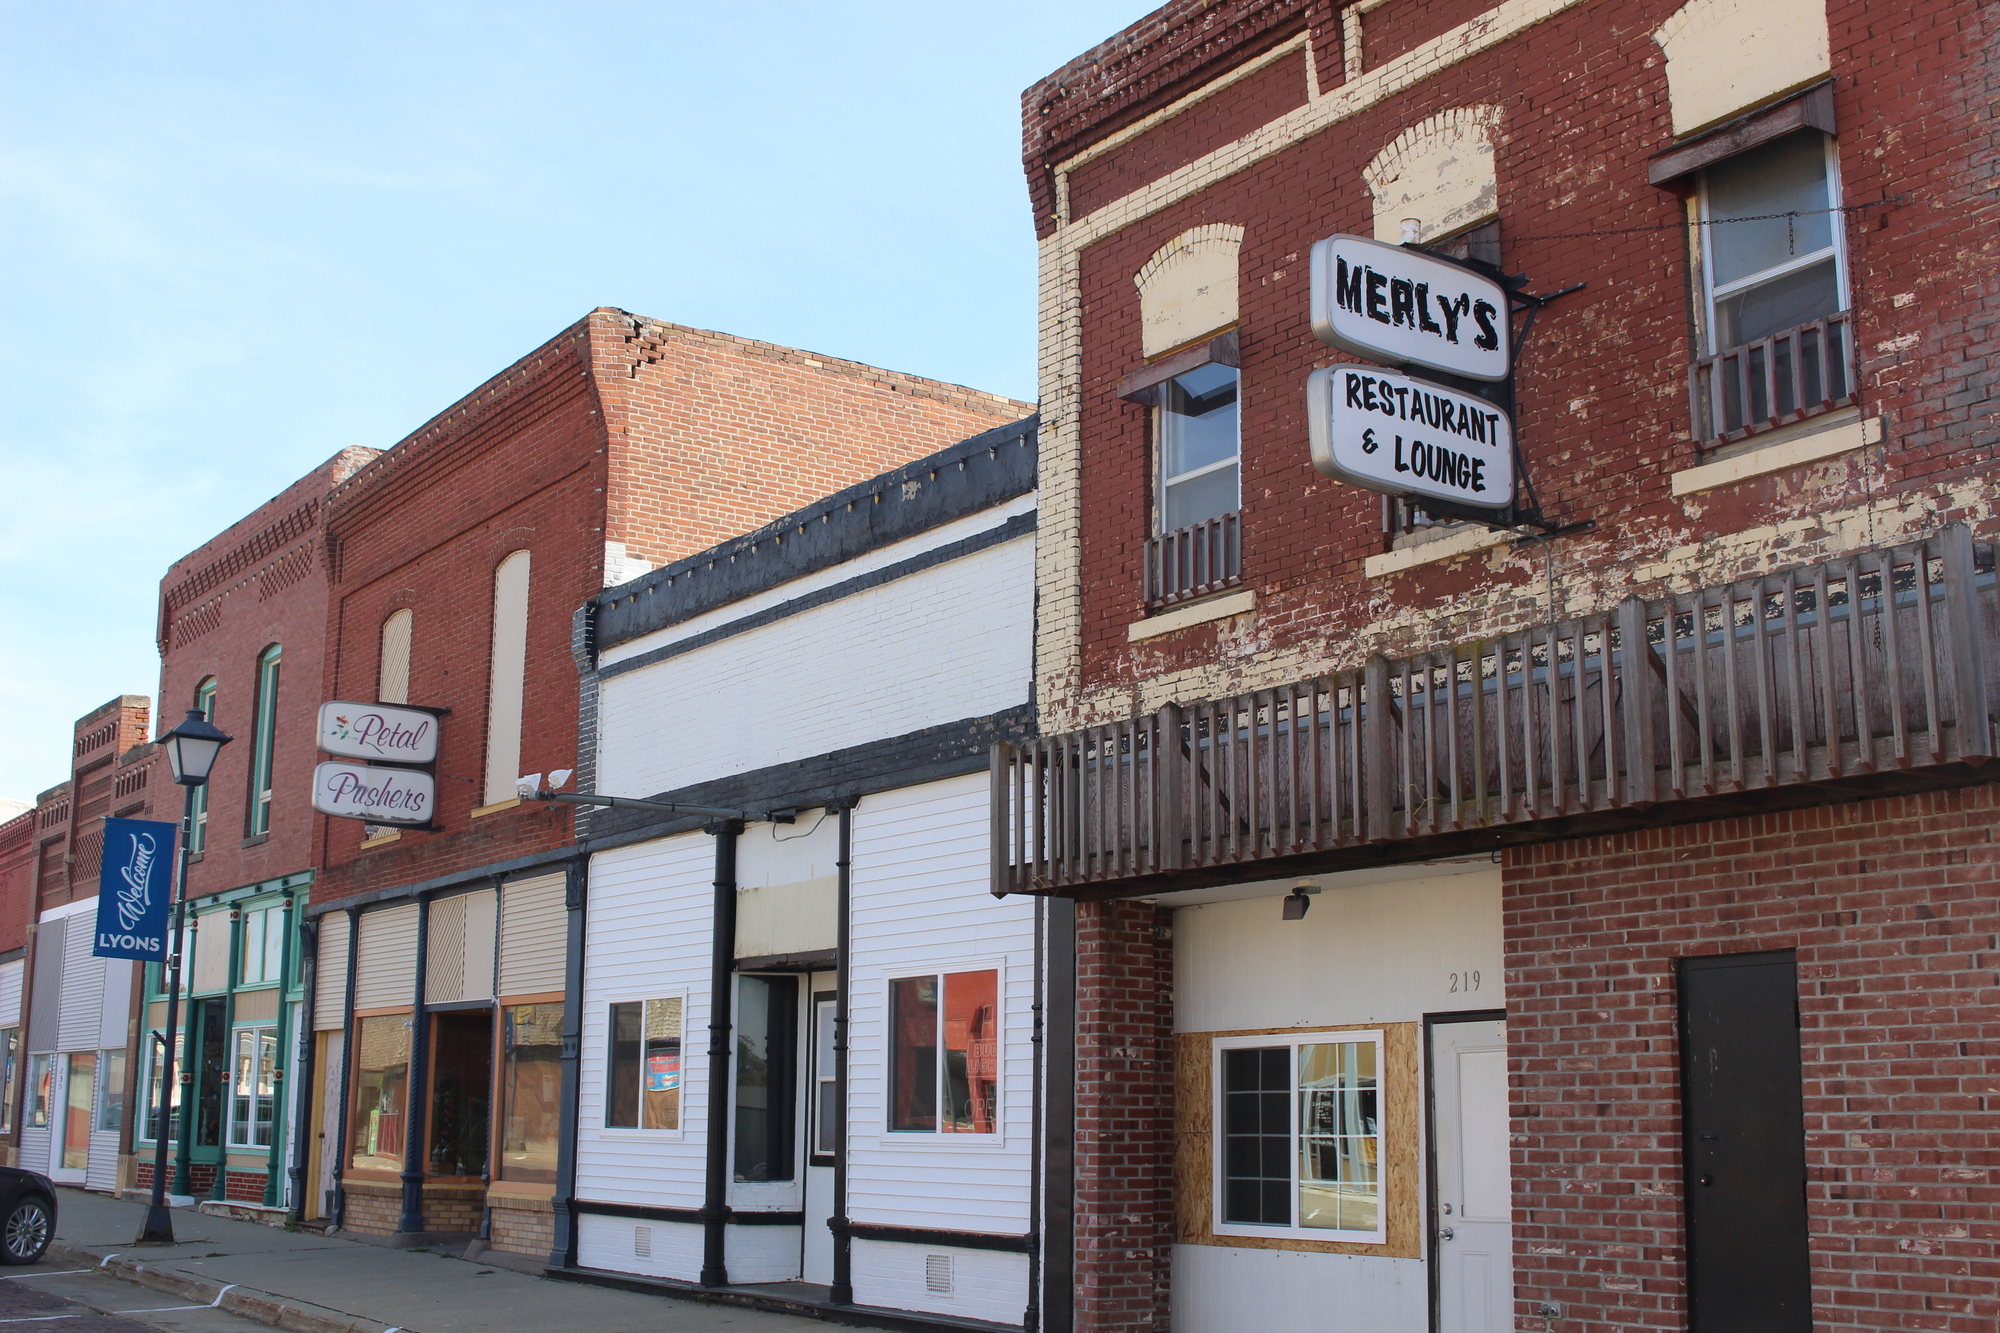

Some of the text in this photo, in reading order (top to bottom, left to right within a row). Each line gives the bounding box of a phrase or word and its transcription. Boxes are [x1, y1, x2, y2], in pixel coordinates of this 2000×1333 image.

[1336, 254, 1499, 351] MERLY'S
[1346, 372, 1499, 447] RESTAURANT
[1361, 427, 1486, 493] & LOUNGE
[353, 713, 429, 751] Petal
[327, 772, 425, 812] Pushers
[117, 832, 156, 931] Welcome
[99, 933, 160, 952] LYONS
[1449, 970, 1480, 993] 219
[968, 1059, 997, 1073] LIGH
[973, 1043, 997, 1058] BUD
[964, 1098, 996, 1119] OPE
